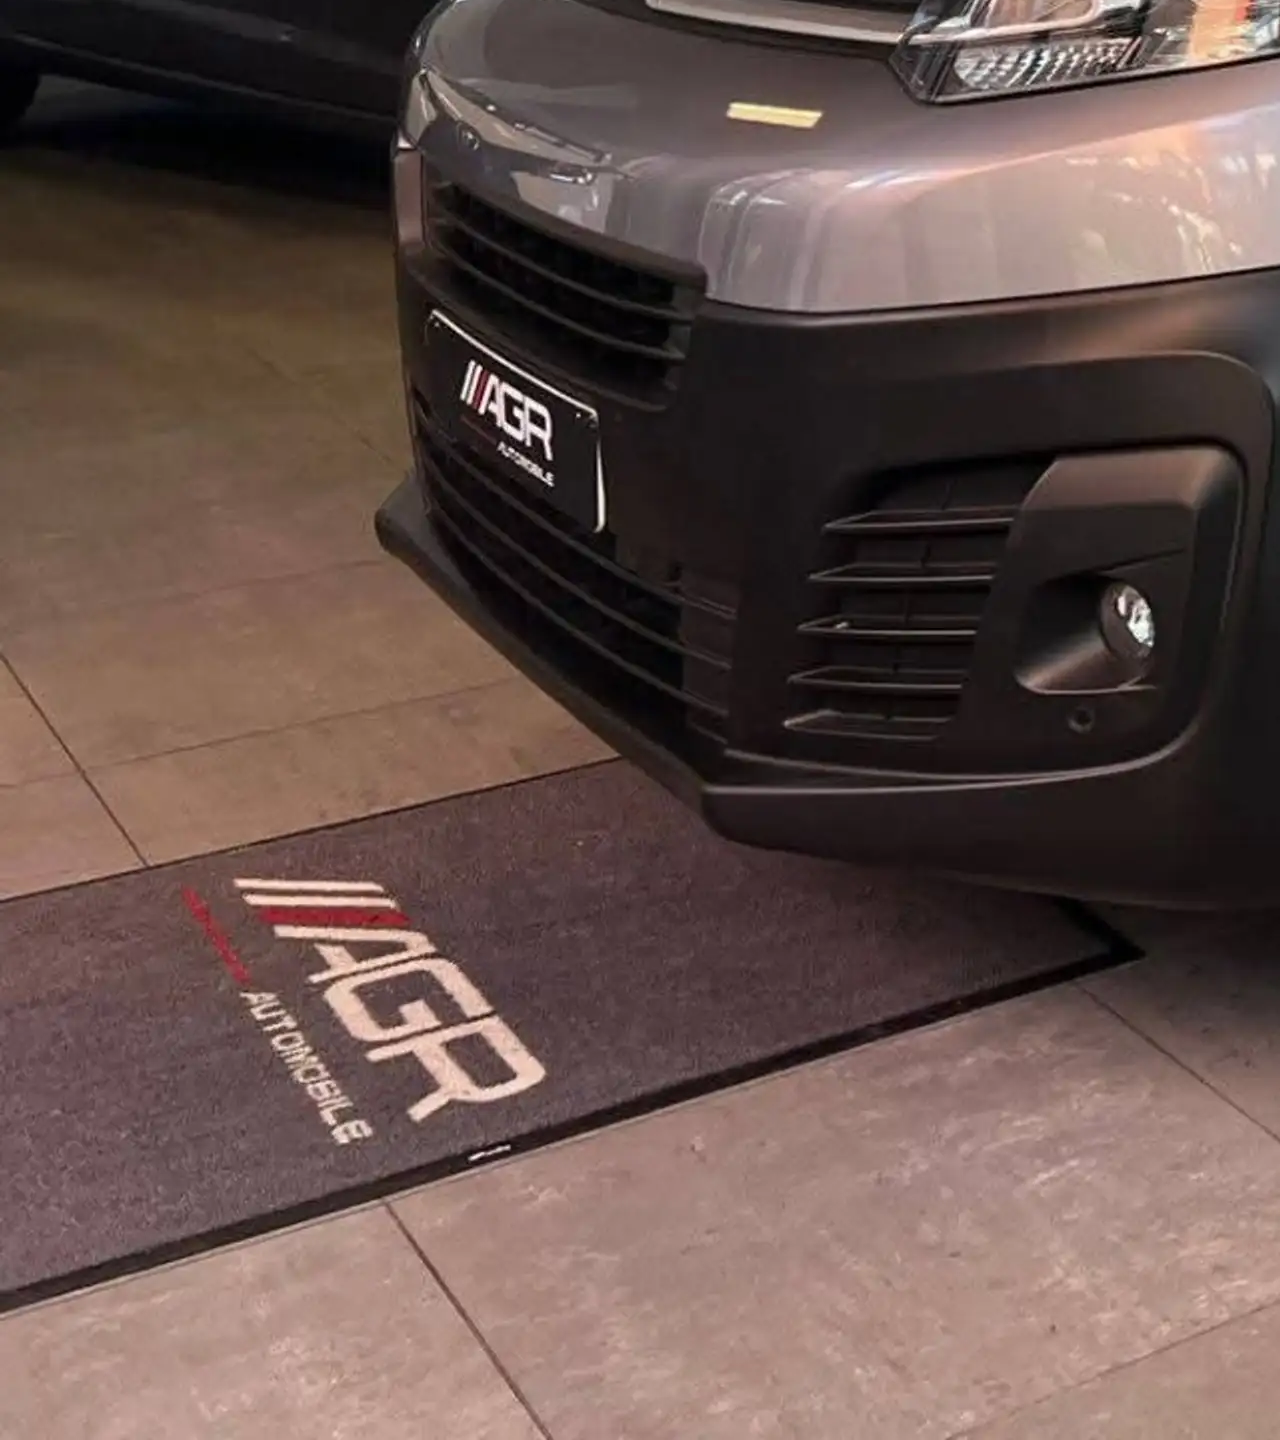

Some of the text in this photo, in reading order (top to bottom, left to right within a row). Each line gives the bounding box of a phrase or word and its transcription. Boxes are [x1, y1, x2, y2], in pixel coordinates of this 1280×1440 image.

[478, 373, 553, 462] AGR
[240, 990, 374, 1146] AUTOMOBILE
[274, 924, 547, 1123] AGR
